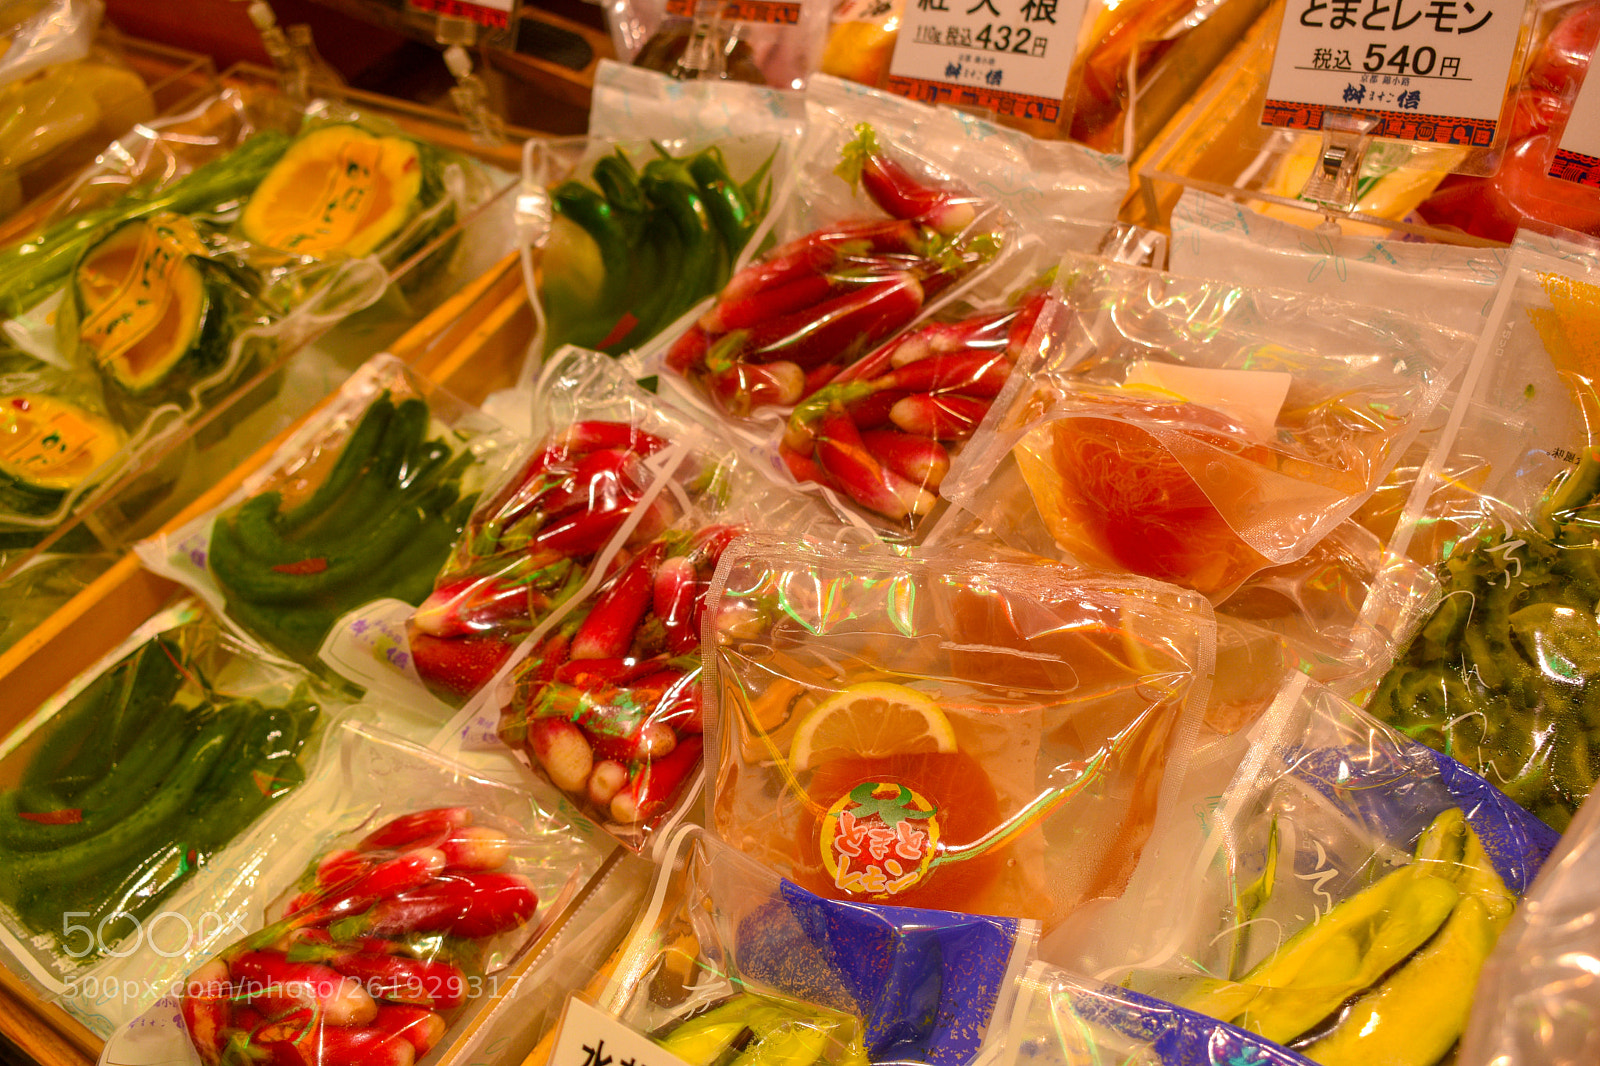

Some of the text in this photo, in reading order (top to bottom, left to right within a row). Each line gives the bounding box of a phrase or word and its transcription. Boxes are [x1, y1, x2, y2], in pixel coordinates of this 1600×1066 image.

[1300, 0, 1493, 35] とまとレモン
[946, 26, 972, 47] 税込
[975, 23, 1048, 57] 432円
[1312, 43, 1461, 78] 税込 540円
[834, 810, 925, 860] とまと
[835, 854, 919, 894] レモン
[577, 1039, 646, 1066] 水
